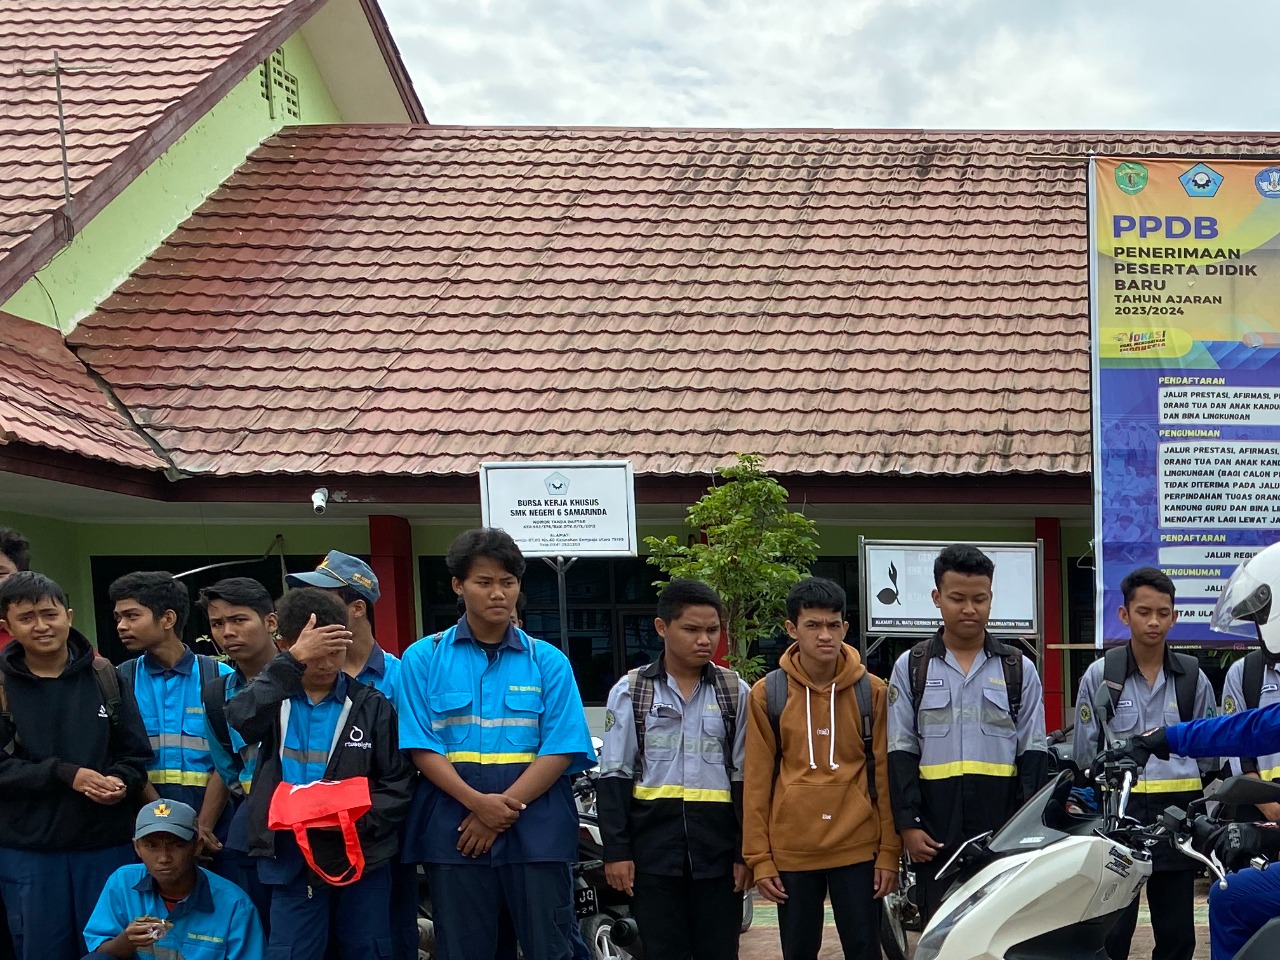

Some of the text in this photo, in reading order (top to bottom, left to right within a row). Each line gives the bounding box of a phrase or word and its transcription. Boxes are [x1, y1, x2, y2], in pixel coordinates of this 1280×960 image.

[1113, 215, 1219, 239] PPDB
[1114, 247, 1240, 259] PENERIMAAN
[1114, 263, 1257, 276] PESERTA DIDIK
[1114, 280, 1166, 290] BARU
[1114, 294, 1222, 304] TAHUN AJARAN
[1114, 306, 1184, 315] 2023/2024
[1158, 377, 1225, 385] PENDAFTARAN
[1159, 430, 1220, 438] PENGUMUMAN
[1193, 447, 1236, 455] PRESTASI,
[1217, 469, 1241, 478] (BAGI
[1243, 470, 1270, 478] CALON
[1218, 516, 1236, 524] LAGI
[1239, 516, 1267, 524] LEWAT
[580, 890, 594, 902] JQ
